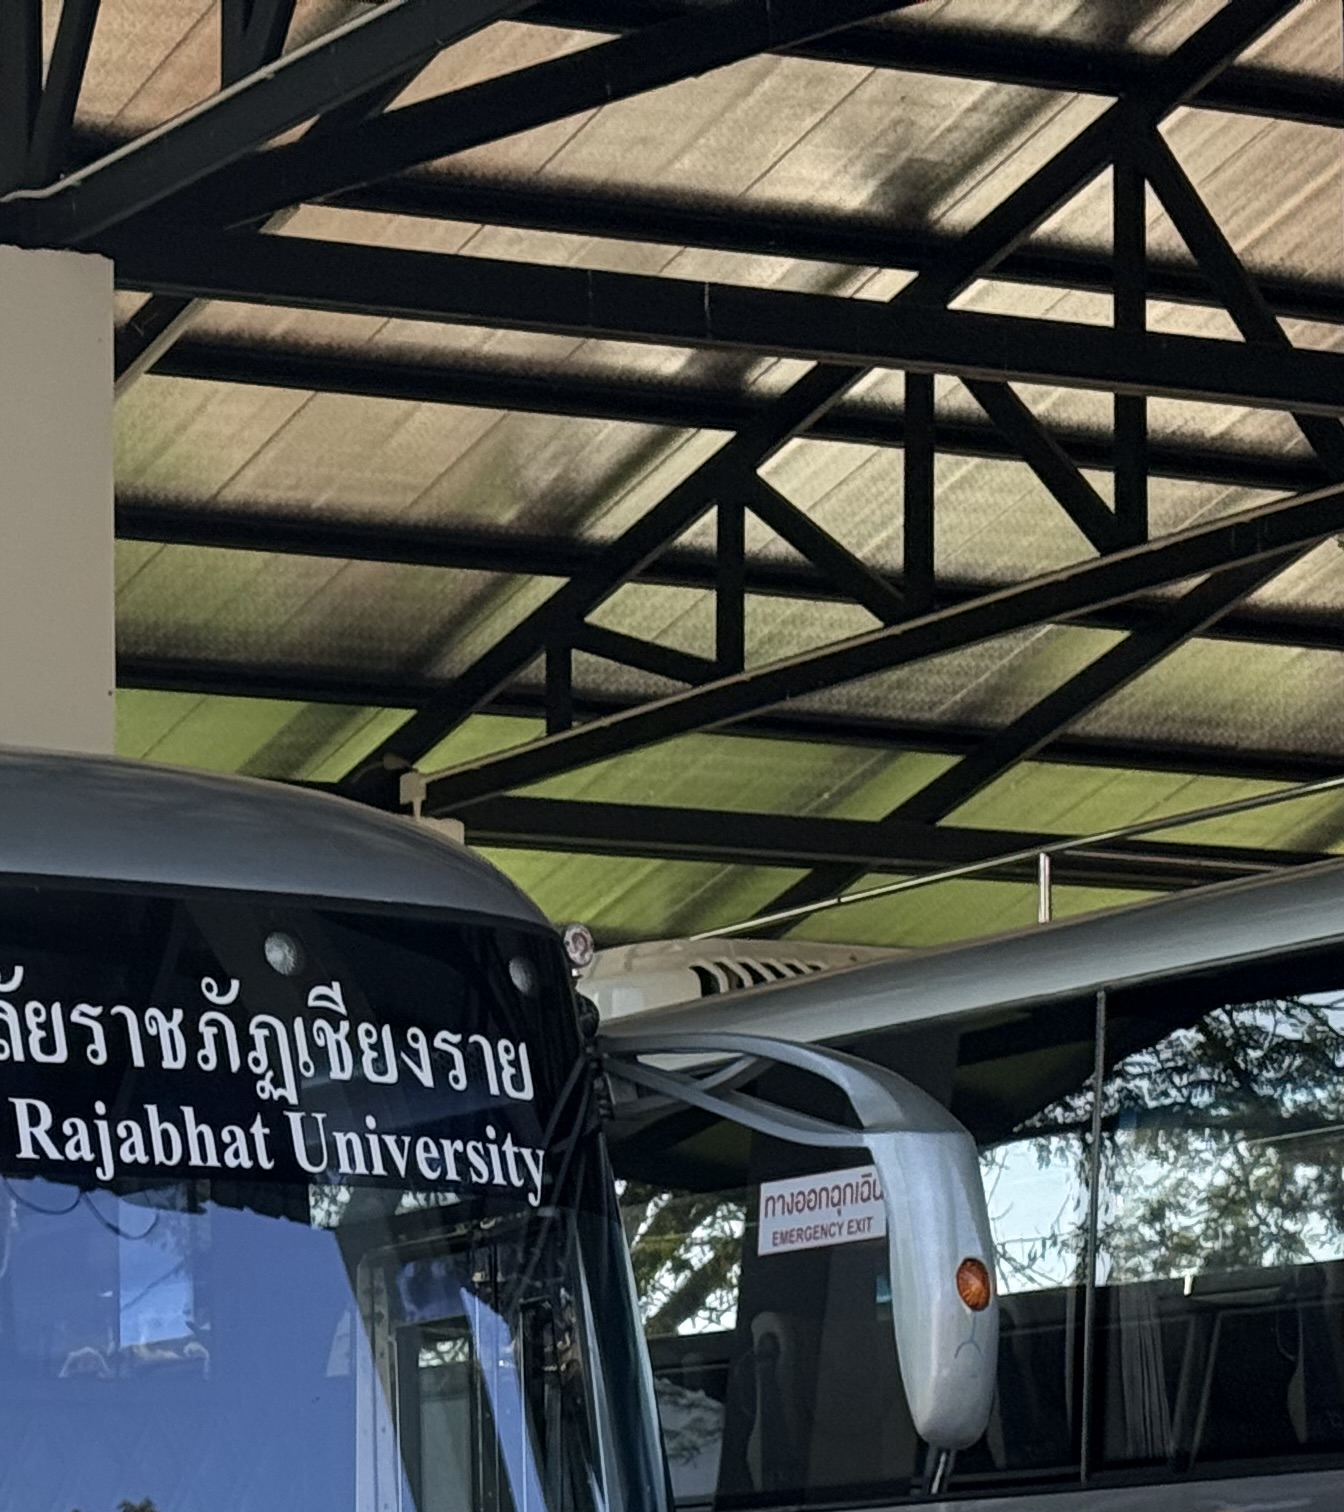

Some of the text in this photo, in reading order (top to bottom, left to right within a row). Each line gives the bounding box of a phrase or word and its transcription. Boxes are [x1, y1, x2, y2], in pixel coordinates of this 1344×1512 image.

[8, 1096, 275, 1181] Rajabhat
[283, 1108, 545, 1207] University
[771, 1216, 874, 1247] EMERGENCY EXIT
